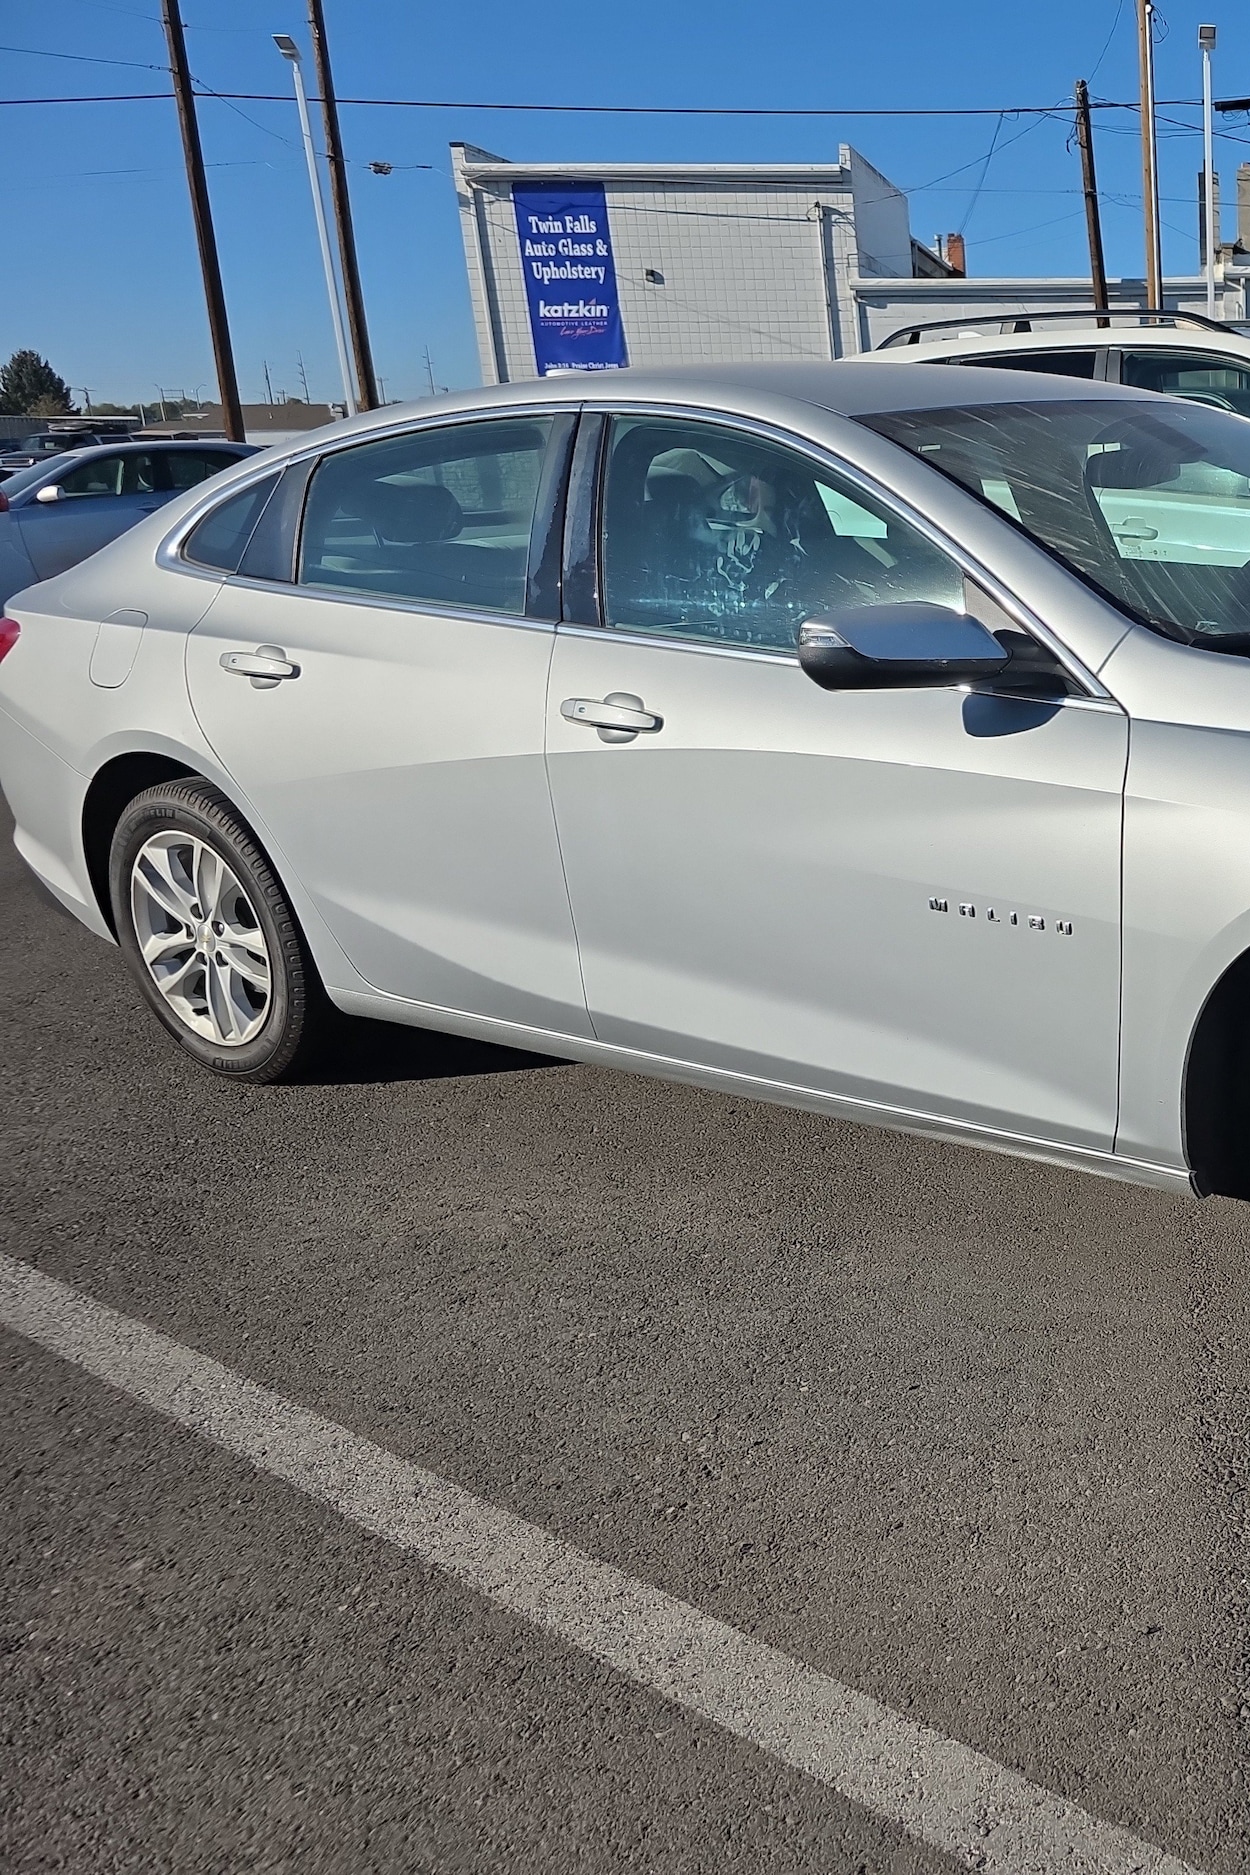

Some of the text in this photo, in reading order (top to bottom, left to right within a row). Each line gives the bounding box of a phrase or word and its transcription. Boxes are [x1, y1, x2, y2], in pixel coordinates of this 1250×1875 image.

[527, 215, 597, 234] Twin Falls
[524, 238, 609, 257] Auto Glass &
[531, 260, 606, 285] Upholstery
[539, 298, 609, 318] katzkin
[928, 896, 1074, 936] MALIBU
